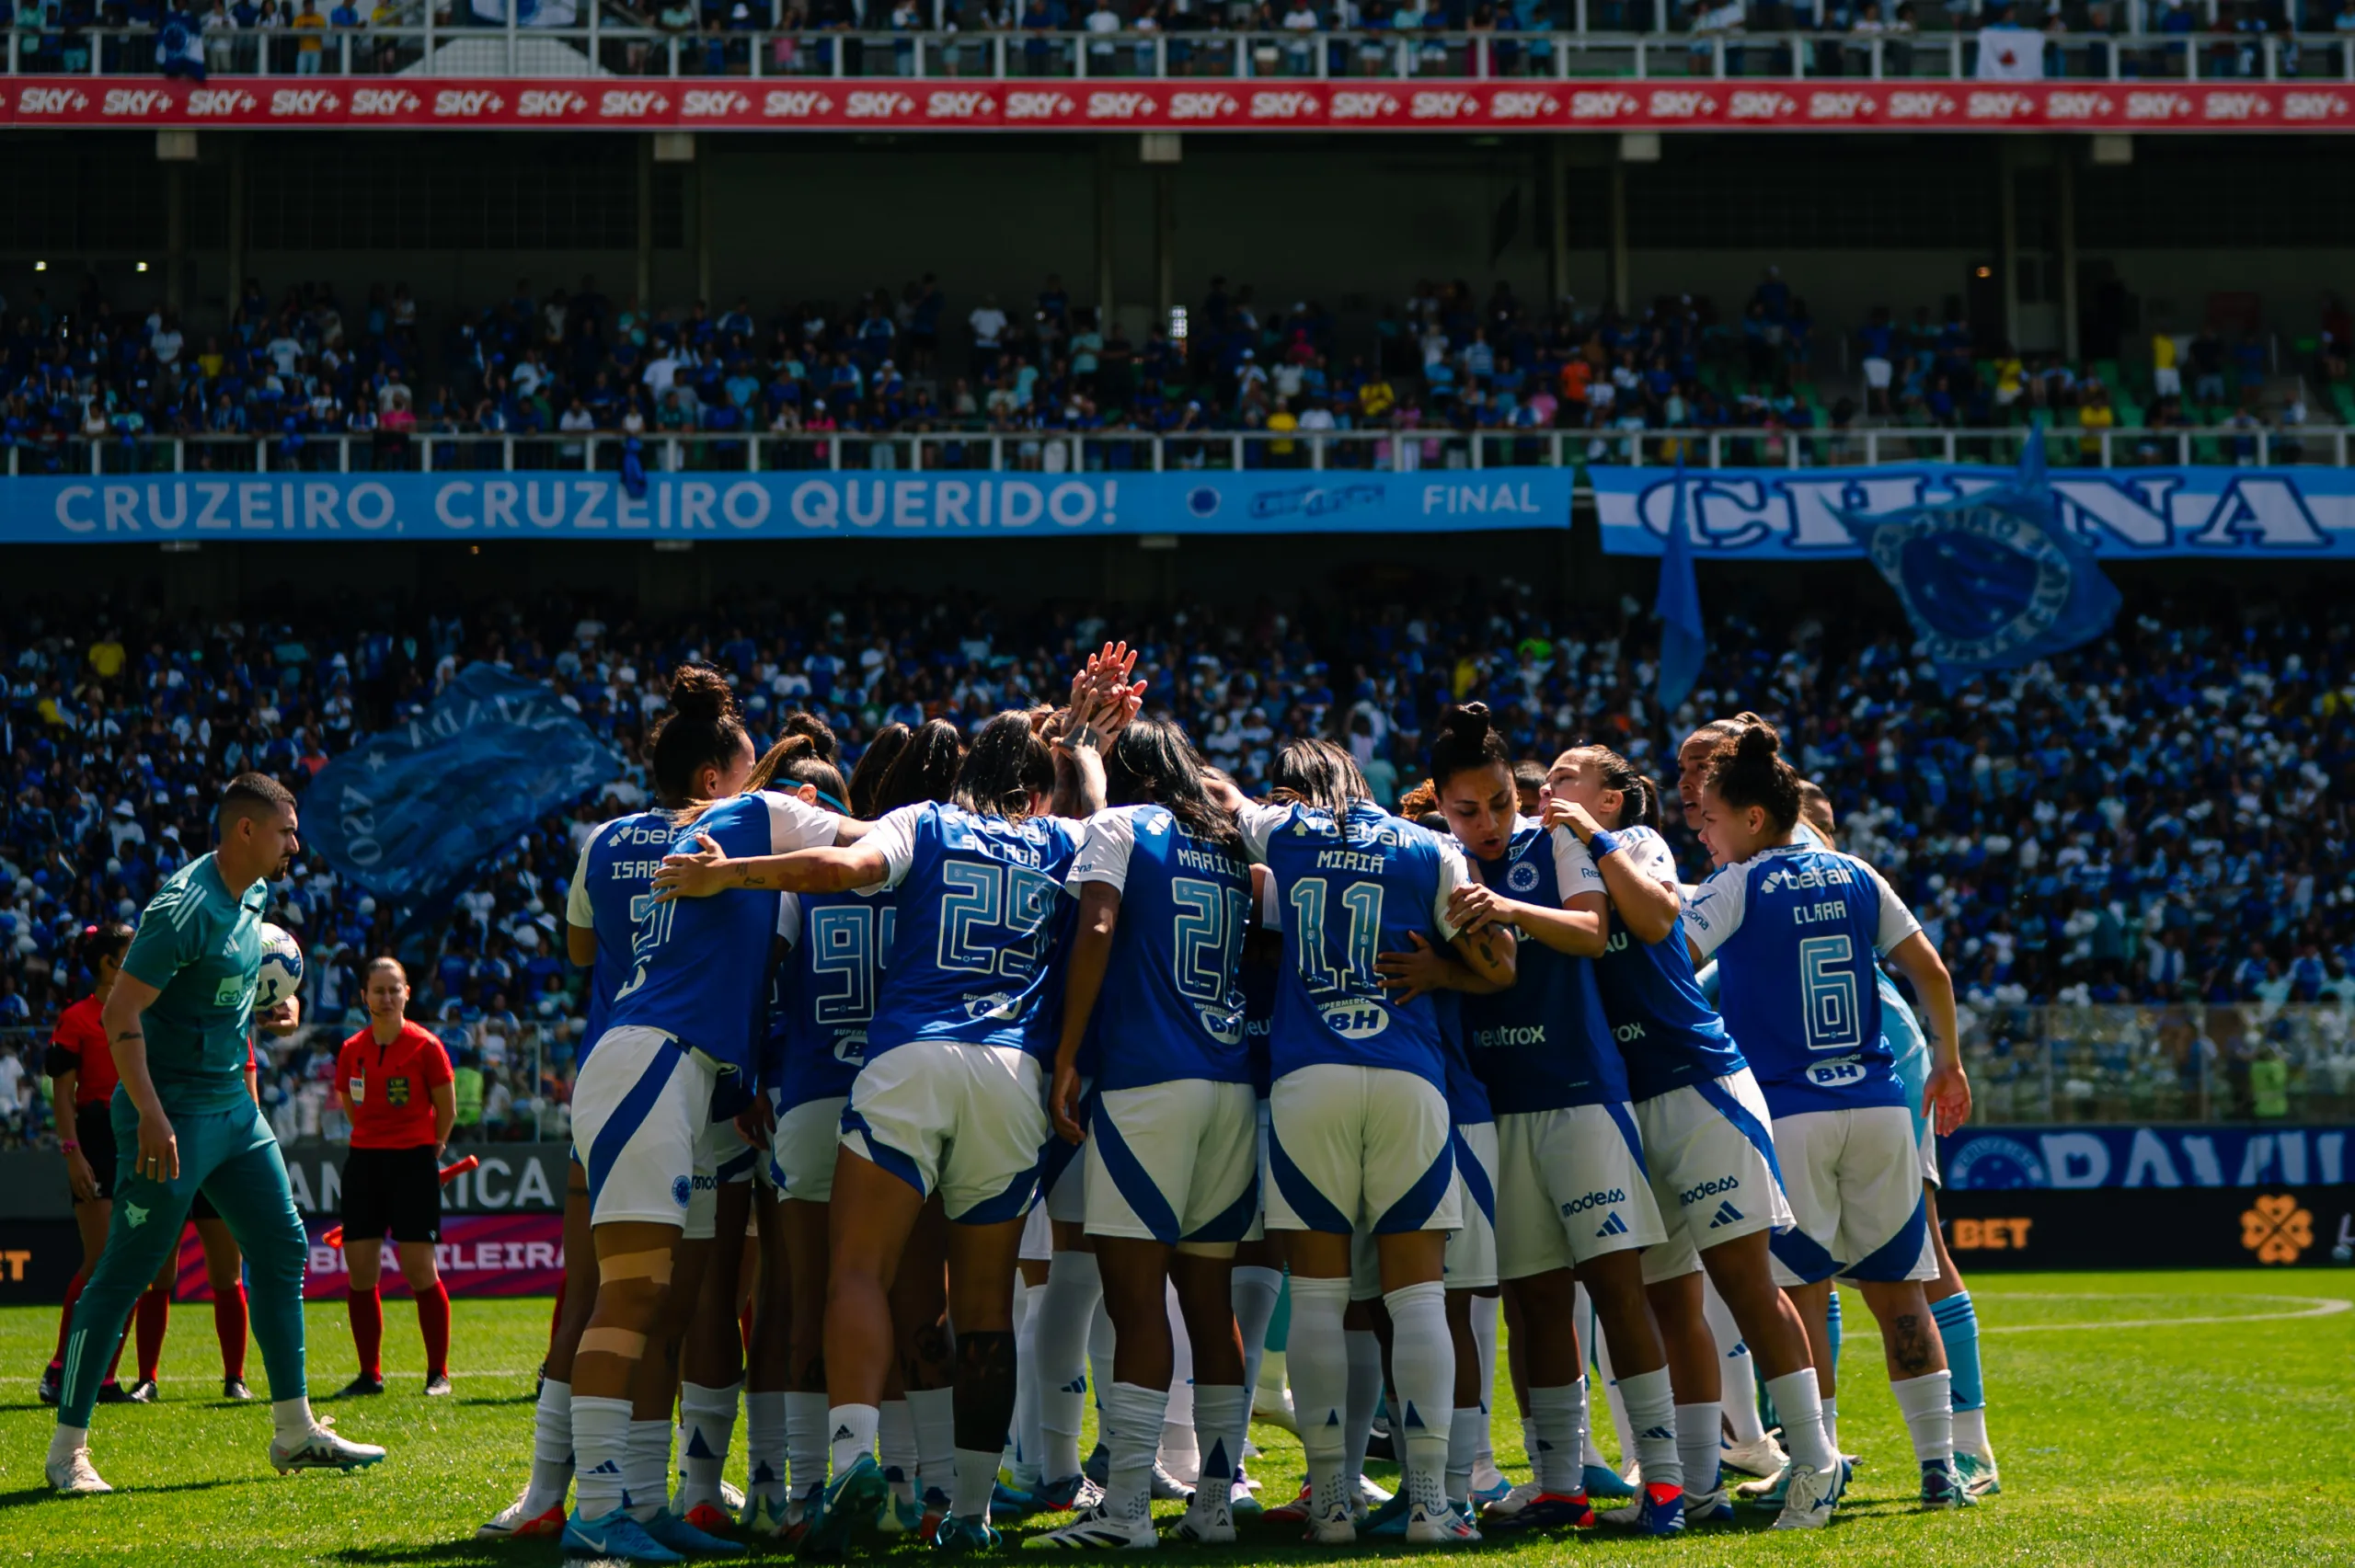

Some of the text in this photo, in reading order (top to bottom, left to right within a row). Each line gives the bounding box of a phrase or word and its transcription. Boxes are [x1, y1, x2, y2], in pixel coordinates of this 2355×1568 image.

[18, 87, 2349, 120] SKY+ SKY+ SKY+ SKY+ SKY+ SKY+ SKY+ SKY+ SKY+ SKY+ SKY+ SKY+ SKY+ SKY+ SKY+ SKY+ SKY+ SKY+ SKY+ SKY+ SKY+ SKY+ SKY+ SKY+ SKY+ SKY+ SKY+ SKY+ SKY+
[55, 482, 405, 534] CRUZEIRO,
[435, 480, 771, 529] CRUZEIRO
[791, 478, 1120, 530] QUERIDO!
[1423, 482, 1541, 515] FINAL
[1781, 864, 1854, 890] betfair
[936, 859, 1061, 985] 29
[1793, 900, 1848, 926] CLARA
[1290, 876, 1387, 1002] 11
[1799, 934, 1861, 1050] 6
[1328, 1009, 1380, 1031] BH
[1474, 1025, 1545, 1047] neutrox
[1814, 1064, 1858, 1083] BH
[1562, 1188, 1626, 1219] modess
